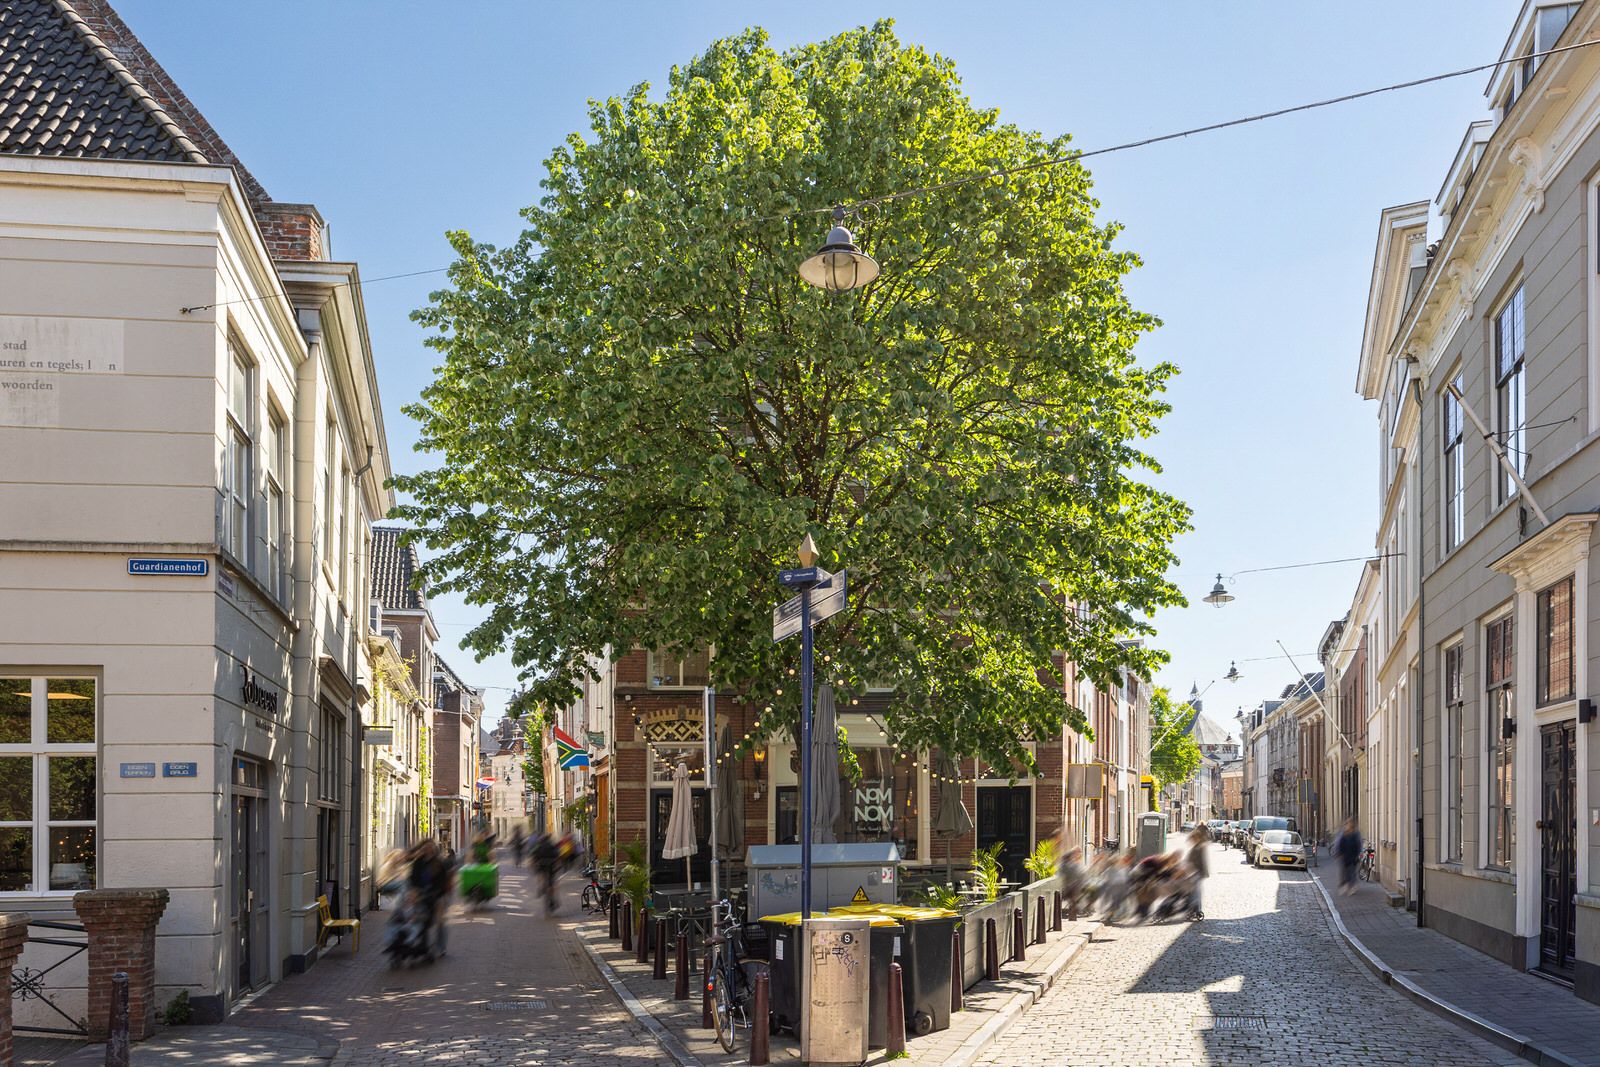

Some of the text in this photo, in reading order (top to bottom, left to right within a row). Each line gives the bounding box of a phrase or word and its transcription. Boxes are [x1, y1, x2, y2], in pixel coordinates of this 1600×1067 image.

[3, 340, 27, 350] stad
[1, 380, 53, 390] woorden
[133, 562, 202, 573] Guardianenhof
[856, 788, 892, 804] NOM
[854, 805, 894, 822] NOM
[844, 934, 850, 943] S
